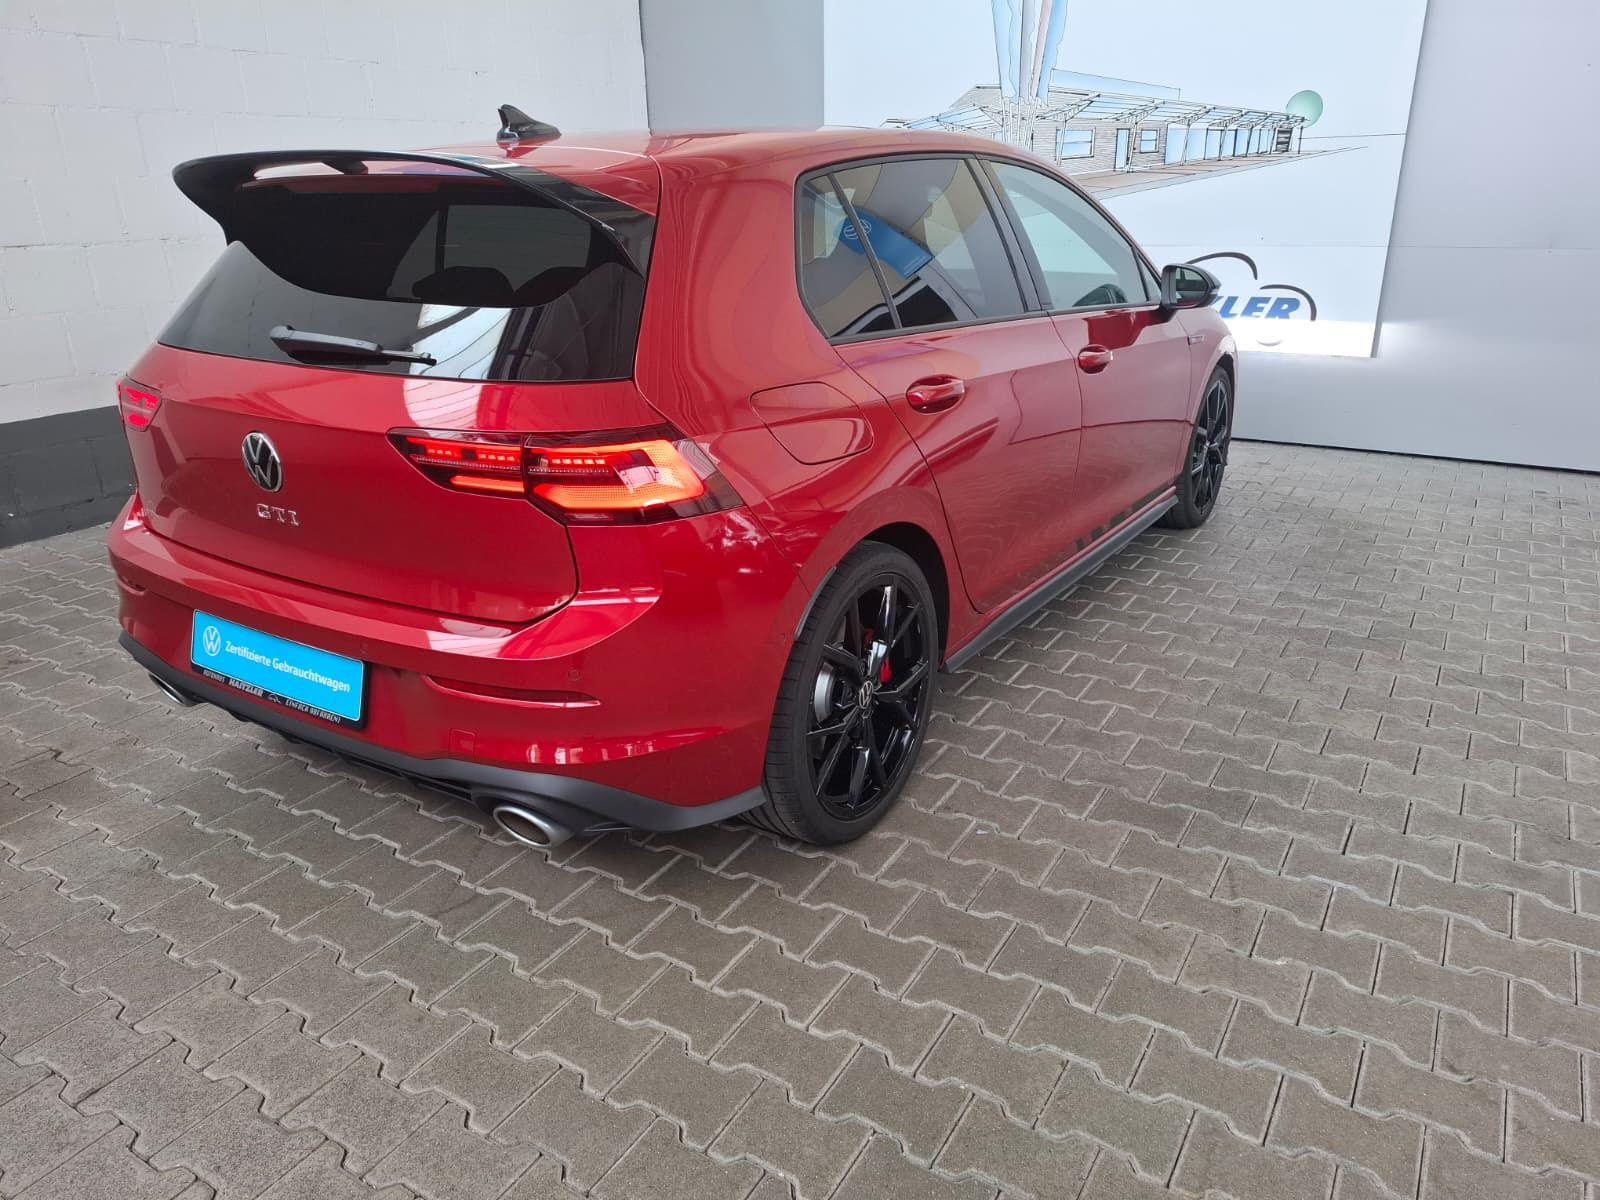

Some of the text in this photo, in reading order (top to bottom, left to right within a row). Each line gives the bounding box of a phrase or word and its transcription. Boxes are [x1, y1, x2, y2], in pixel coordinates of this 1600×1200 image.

[257, 503, 299, 526] GTI
[225, 640, 351, 692] Zertifizierte Gebrauchtwagen
[229, 678, 264, 697] HAITZLER
